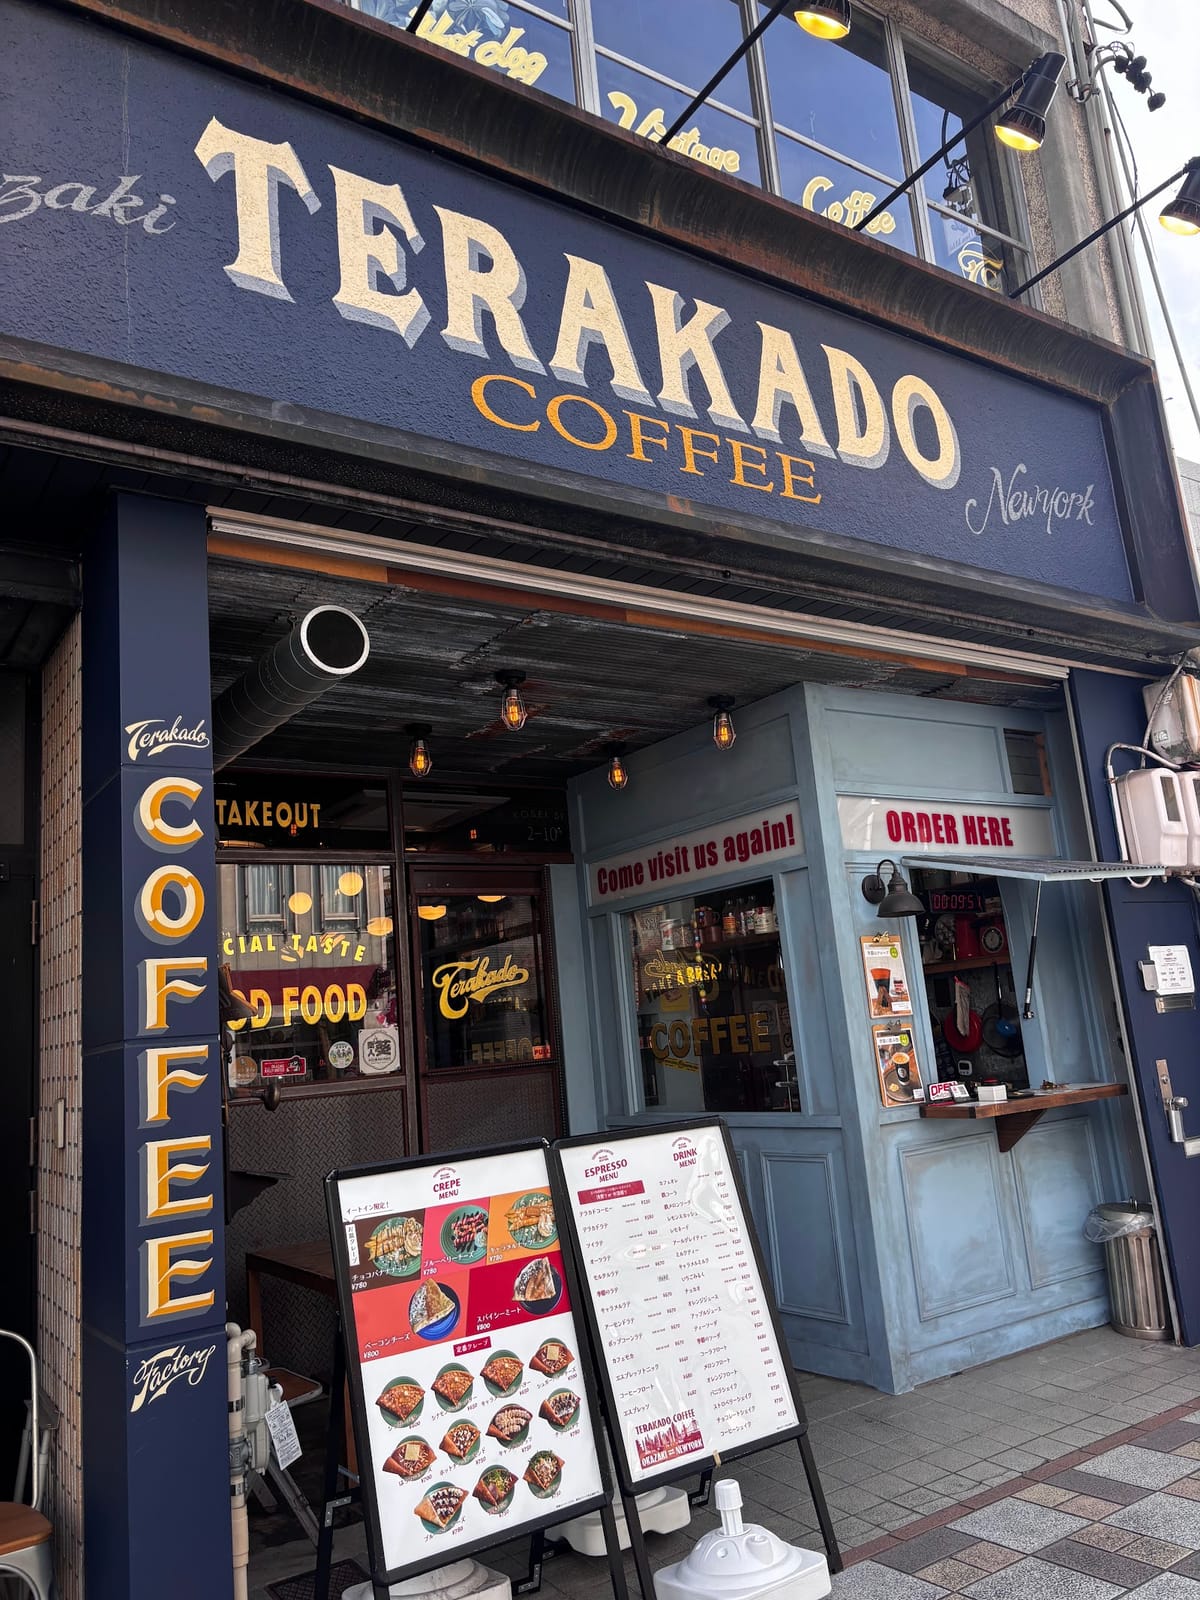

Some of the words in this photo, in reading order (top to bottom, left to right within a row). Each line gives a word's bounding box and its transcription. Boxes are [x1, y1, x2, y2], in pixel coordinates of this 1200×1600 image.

[194, 116, 962, 490] TERAKADO
[470, 374, 821, 505] COFFEE
[124, 714, 210, 761] Terakado
[215, 799, 321, 828] TAKEOUT
[886, 809, 958, 845] ORDER
[962, 814, 1014, 847] HERE
[597, 860, 644, 895] Come
[647, 846, 690, 882] visit
[694, 840, 718, 870] us
[723, 813, 796, 863] again!
[291, 933, 367, 963] TASTE
[432, 954, 529, 1020] Terakado
[283, 983, 367, 1026] FOOD
[650, 1012, 772, 1060] COFFEE
[133, 776, 214, 1327] COFFEE
[584, 1158, 628, 1178] ESPRESSO
[673, 1147, 698, 1162] DRINK
[679, 1157, 697, 1169] MENU
[433, 1177, 461, 1193] CREPE
[599, 1171, 619, 1183] MENU
[438, 1188, 459, 1200] MENU
[363, 1349, 380, 1359] ¥800
[364, 1332, 411, 1349] ベーコンチーズ
[130, 1343, 217, 1413] Factory
[635, 1414, 672, 1435] TERAKADO
[672, 1408, 696, 1424] COFFEE
[641, 1449, 668, 1467] OKAZAKI
